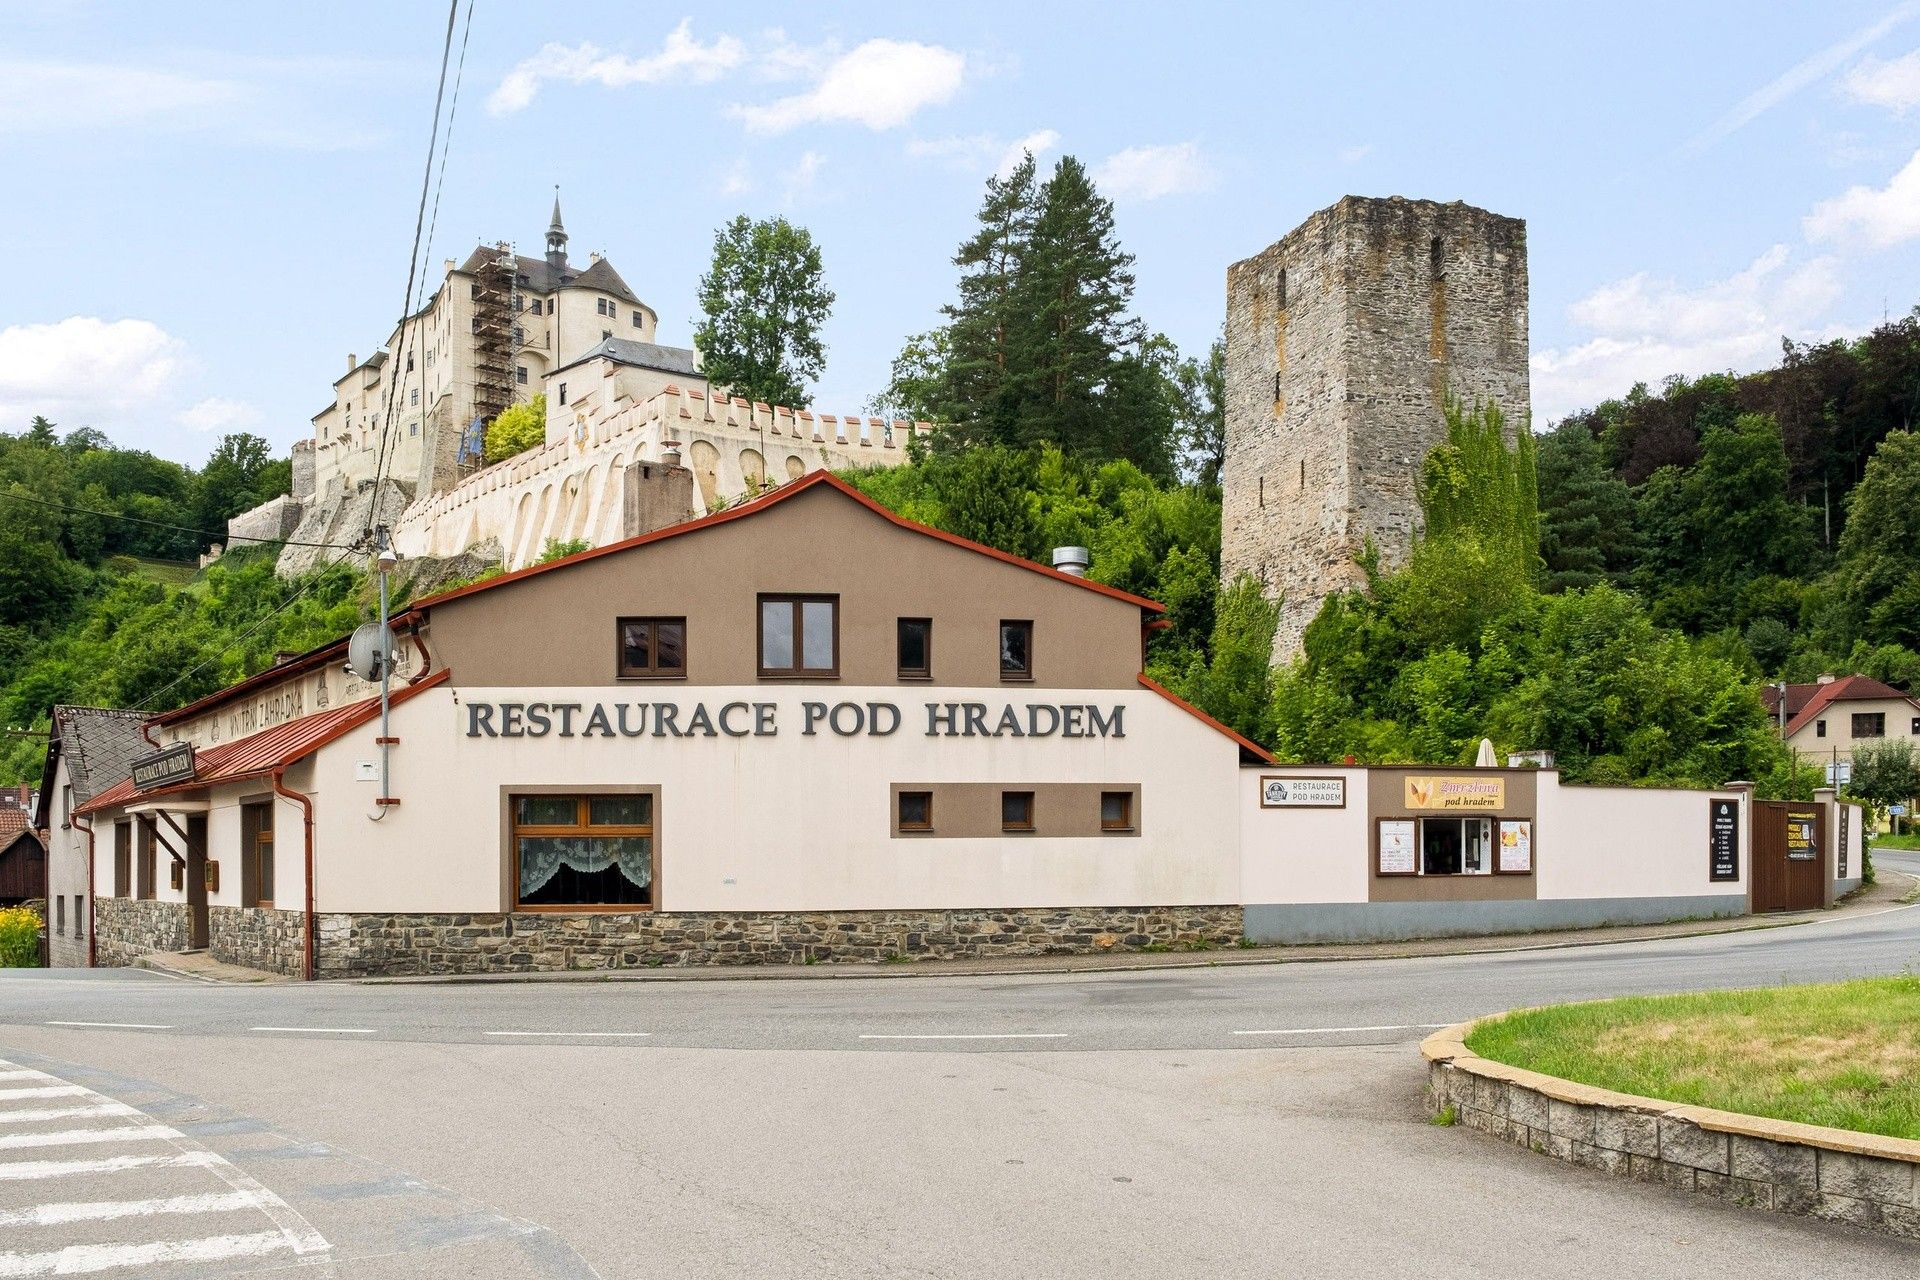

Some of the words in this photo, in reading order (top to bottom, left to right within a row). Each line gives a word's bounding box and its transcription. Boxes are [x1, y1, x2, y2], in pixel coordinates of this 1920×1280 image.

[466, 702, 778, 738] RESTAURACE
[801, 702, 901, 737] POD
[924, 702, 1126, 738] HRADEM
[157, 760, 169, 776] POD
[1292, 782, 1341, 791] RESTAURACE
[1440, 778, 1499, 793] Zmrzlina
[1292, 793, 1308, 801] POD
[1310, 793, 1341, 801] HRADEM
[1444, 797, 1461, 808] pod
[1463, 797, 1495, 806] hradem
